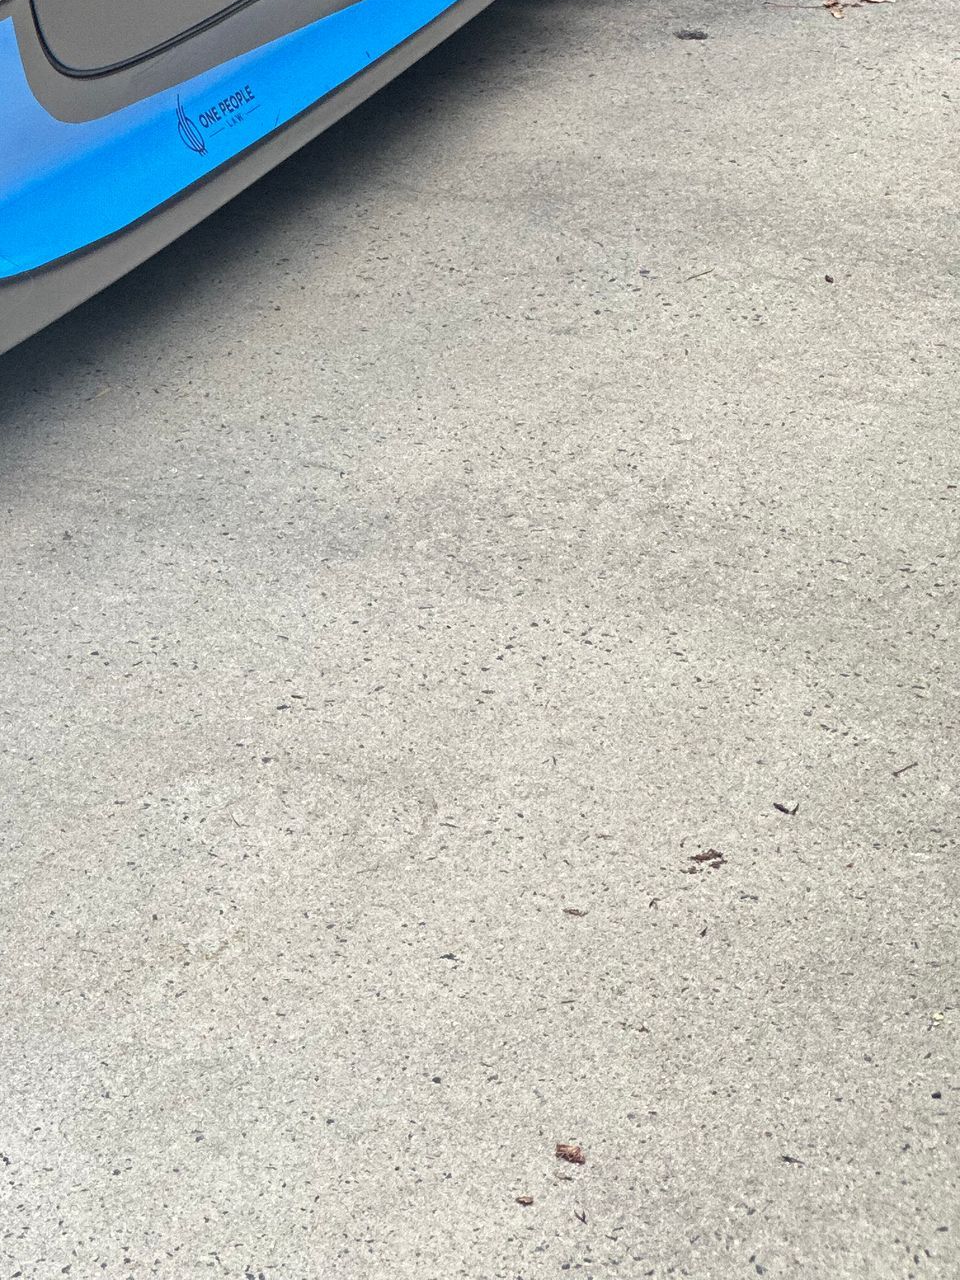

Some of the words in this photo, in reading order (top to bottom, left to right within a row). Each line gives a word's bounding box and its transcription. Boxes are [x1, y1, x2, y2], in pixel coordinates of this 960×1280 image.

[198, 106, 222, 128] ONE
[218, 84, 255, 116] PEOPLE
[226, 113, 244, 128] LAW
